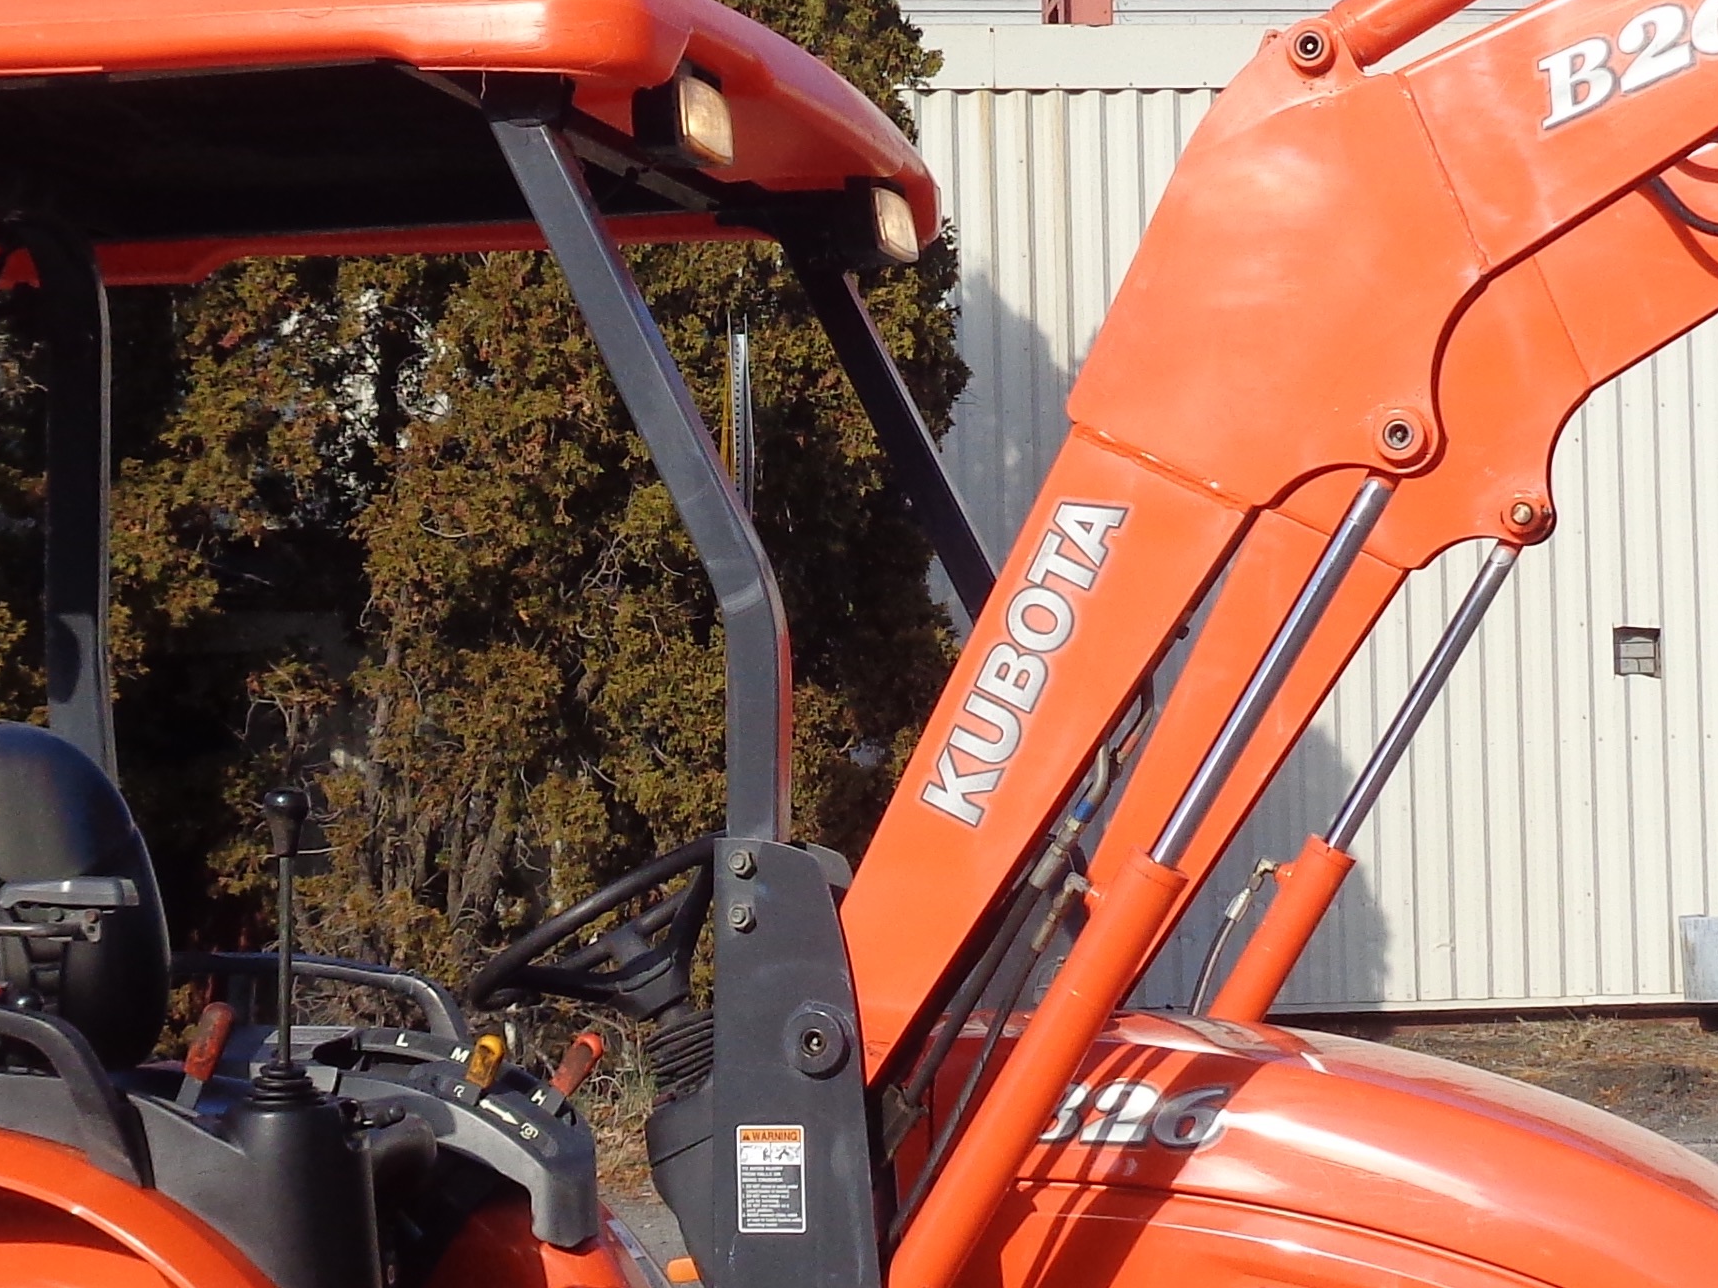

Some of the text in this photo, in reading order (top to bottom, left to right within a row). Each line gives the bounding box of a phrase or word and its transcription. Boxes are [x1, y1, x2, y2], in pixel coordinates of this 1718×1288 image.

[921, 501, 1130, 828] KUBOTA
[395, 1032, 547, 1107] L M H
[751, 1130, 798, 1141] WARNING
